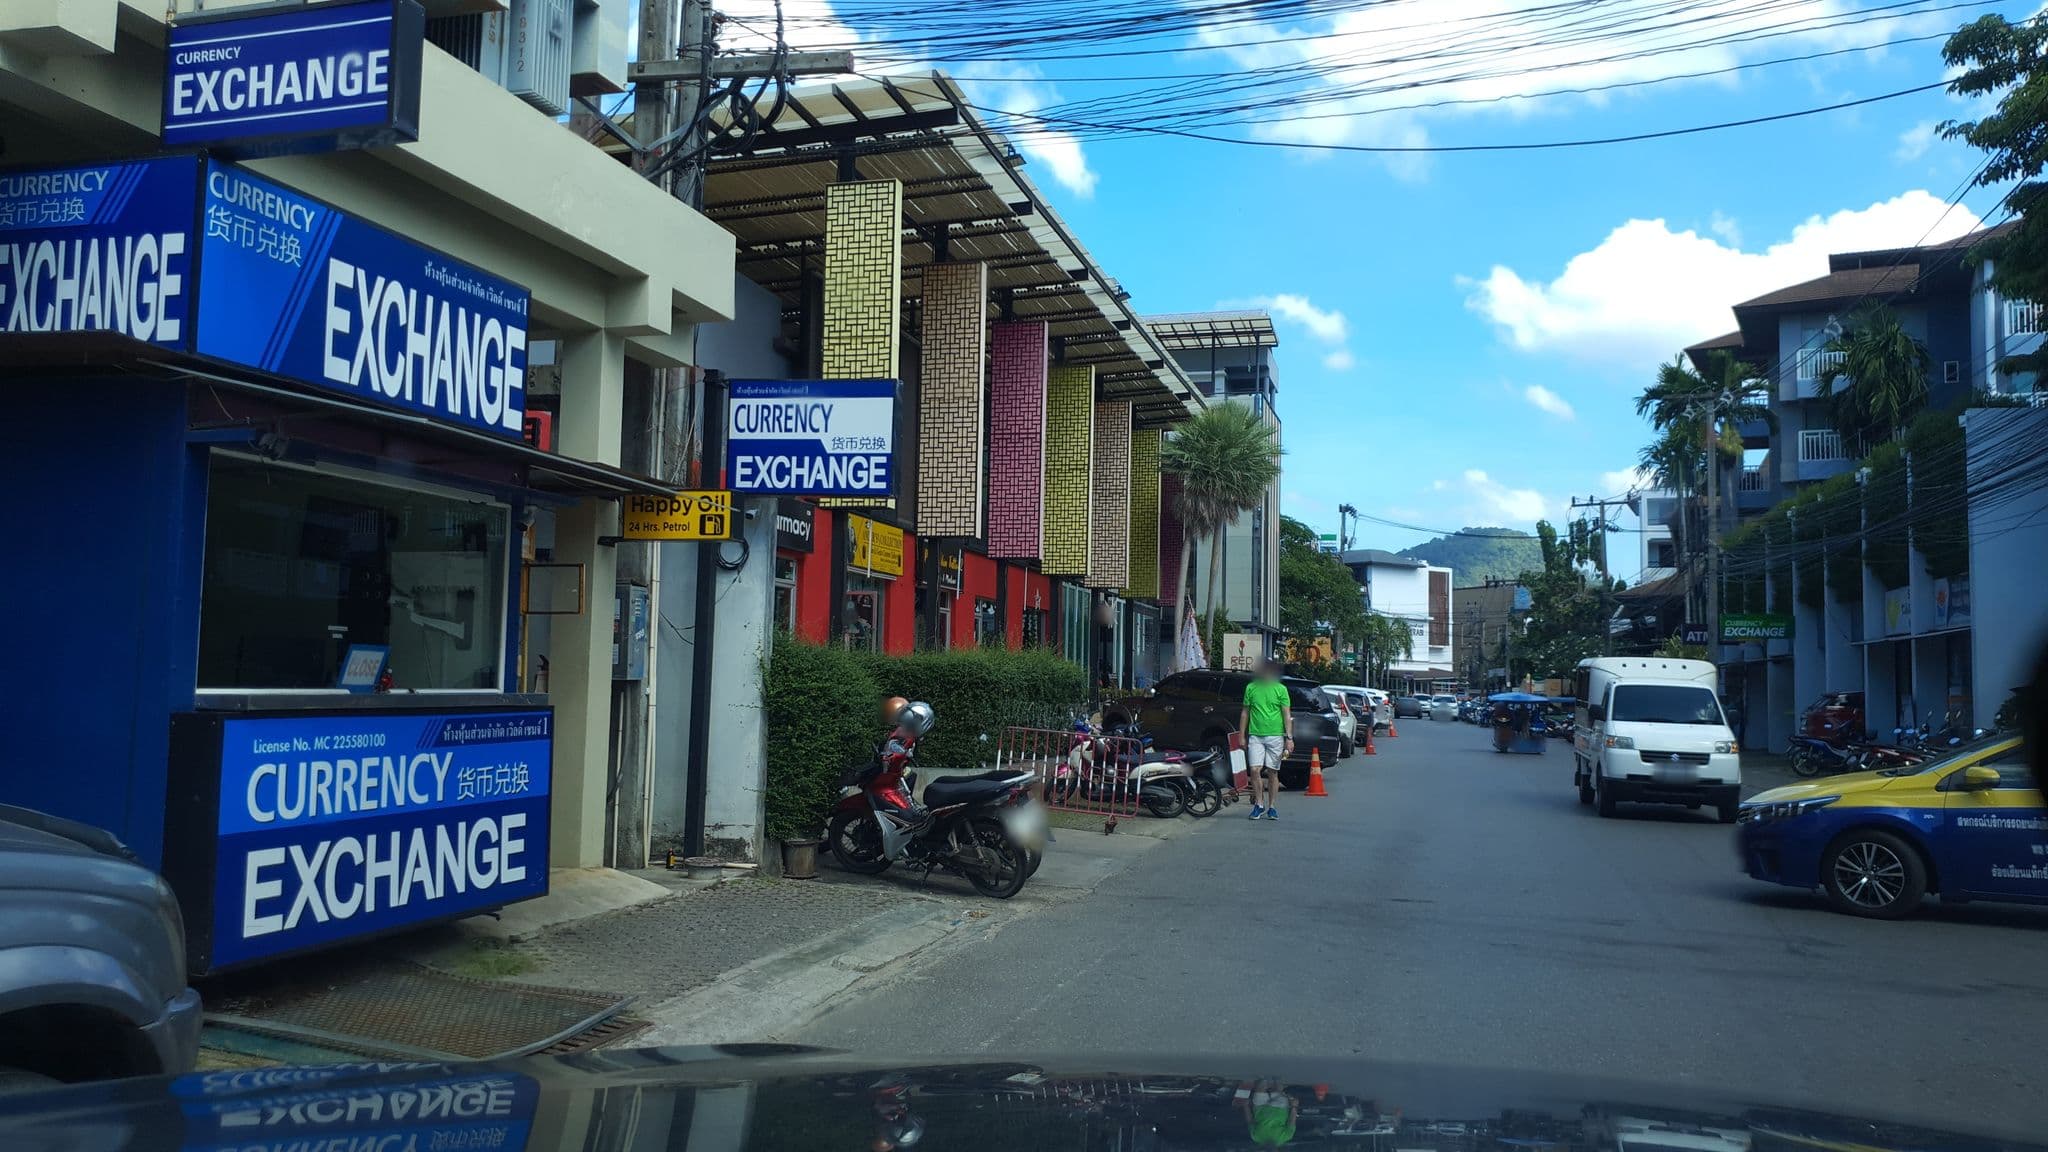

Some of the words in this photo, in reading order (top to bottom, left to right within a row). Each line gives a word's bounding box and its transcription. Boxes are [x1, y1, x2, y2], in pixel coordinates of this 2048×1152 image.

[176, 46, 242, 65] CURRENCY
[172, 50, 390, 115] EXCHANGE
[209, 171, 315, 232] CURRENCY
[207, 205, 302, 267] 货币兑换
[323, 257, 526, 431] EXCHANGE
[734, 403, 833, 433] CURRENCY
[831, 436, 886, 450] 货币兑换
[735, 455, 887, 489] EXCHANGE
[631, 495, 693, 516] Happy
[698, 495, 725, 512] Oil
[629, 521, 640, 532] 24
[643, 522, 661, 532] Hrs.
[663, 521, 690, 532] Petrol
[1724, 627, 1785, 637] EXCHANGE
[1231, 655, 1254, 665] RED
[542, 717, 548, 734] 1
[254, 738, 290, 754] License
[293, 737, 311, 751] No.
[314, 736, 330, 750] MC
[333, 733, 386, 749] 225580100
[247, 752, 454, 823] CURRENCY
[456, 761, 530, 800] 货币兑换
[243, 812, 527, 938] EXCHANGE
